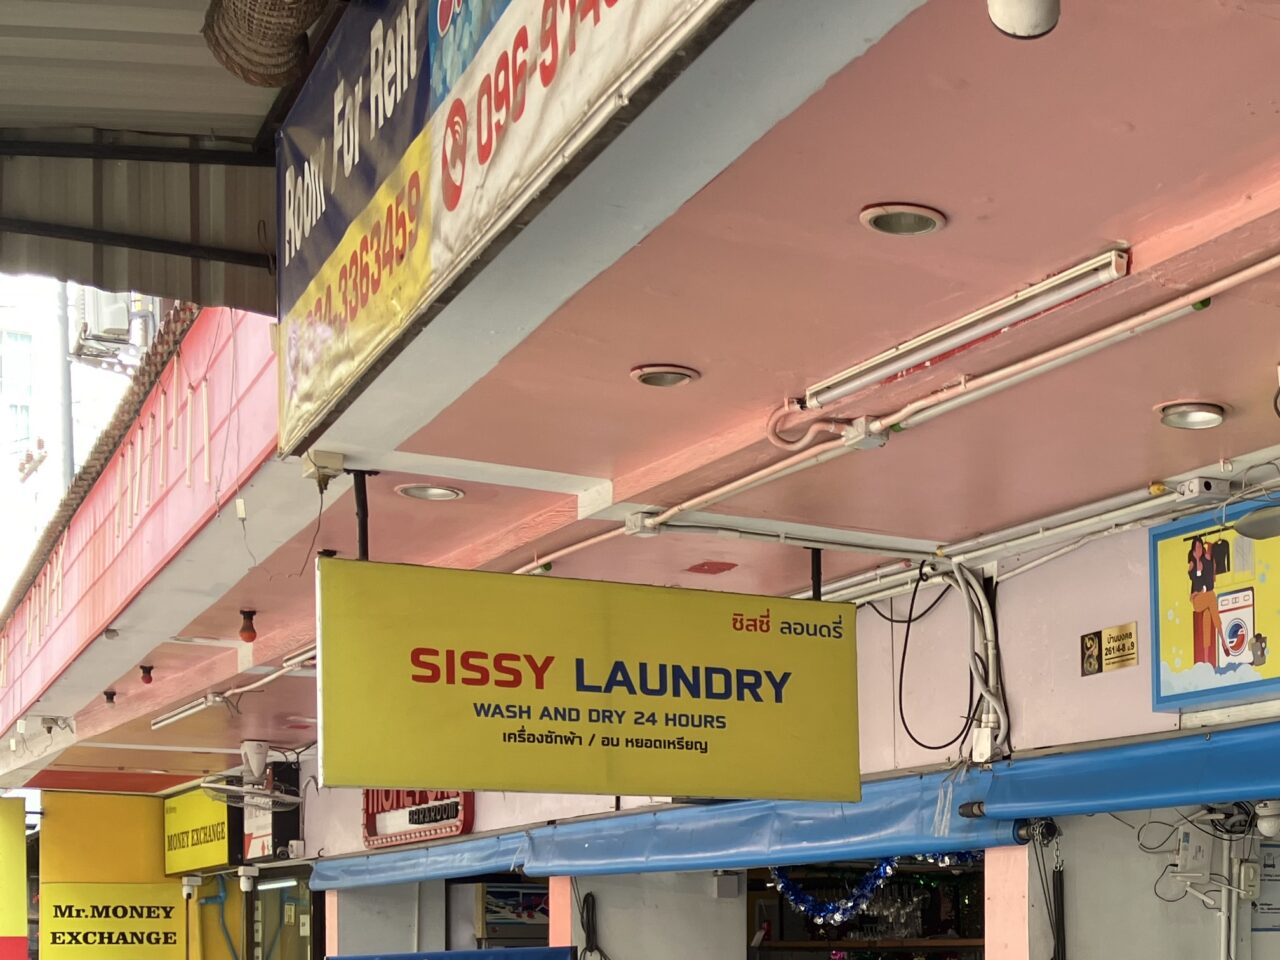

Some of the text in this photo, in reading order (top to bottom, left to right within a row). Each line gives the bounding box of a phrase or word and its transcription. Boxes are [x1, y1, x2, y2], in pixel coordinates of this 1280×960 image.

[476, 0, 618, 166] 096-91
[285, 0, 419, 268] Room For Rent
[732, 608, 771, 633] ซิสซี่
[410, 647, 792, 704] SISSY LAUNDRY
[473, 702, 727, 729] WASH AND DRY 24 HOURS
[502, 725, 583, 746] เครื่องซักผ้า
[601, 735, 620, 748] อบ
[625, 736, 708, 753] หยอดเหรียญ
[167, 821, 226, 852] MONEY EXCHANGE
[52, 905, 175, 919] Mr.MONEY
[50, 931, 177, 945] EXCHANGE
